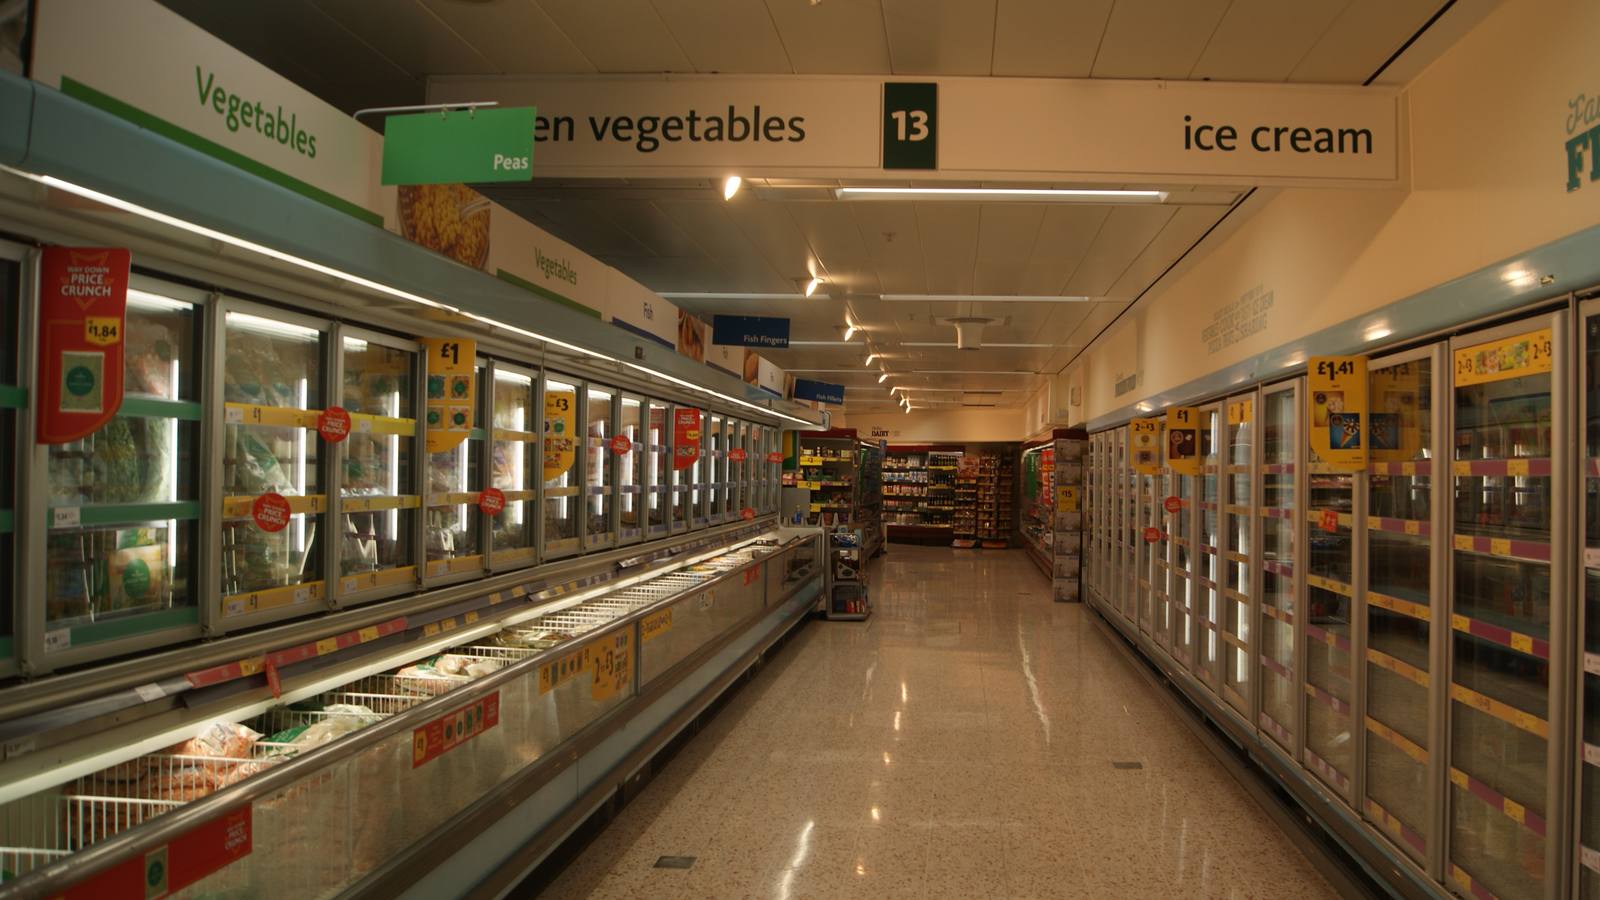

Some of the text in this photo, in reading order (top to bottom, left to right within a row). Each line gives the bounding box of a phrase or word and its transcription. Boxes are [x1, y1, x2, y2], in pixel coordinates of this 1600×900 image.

[195, 65, 317, 159] Vegetables
[588, 105, 806, 153] vegetables
[891, 110, 929, 142] 13
[1183, 114, 1374, 154] ice cream
[493, 153, 529, 171] Peas
[534, 247, 577, 285] Vegetables
[70, 274, 104, 285] PRICE
[60, 285, 112, 297] CRUNCH
[743, 334, 788, 346] Fish Fingers
[441, 343, 459, 364] £1
[1317, 361, 1354, 381] £1.41
[556, 398, 569, 411] £3
[1177, 409, 1188, 423] £1
